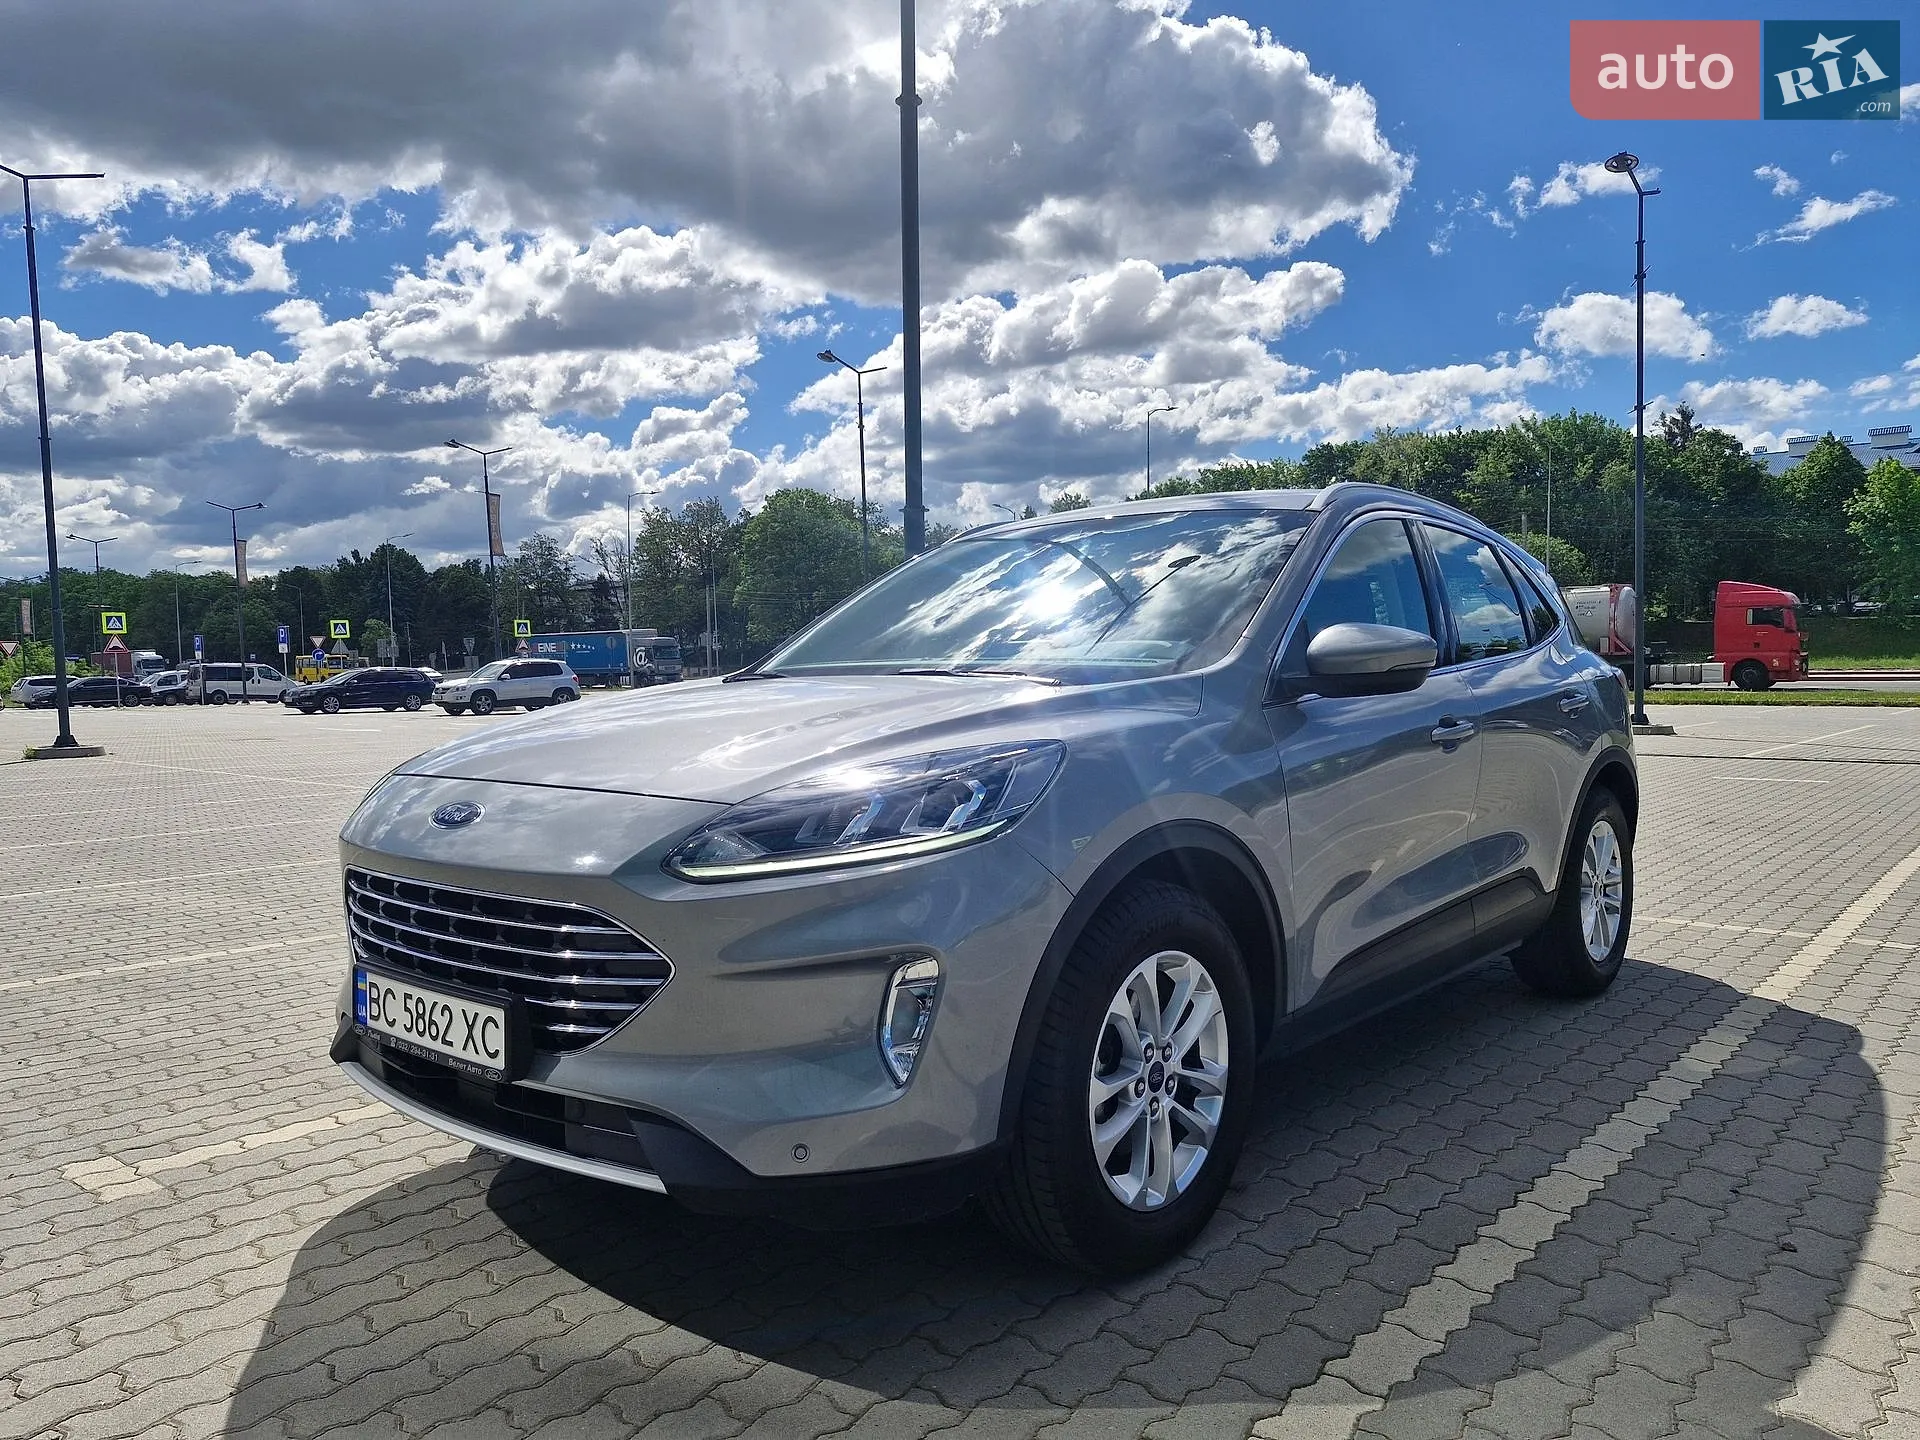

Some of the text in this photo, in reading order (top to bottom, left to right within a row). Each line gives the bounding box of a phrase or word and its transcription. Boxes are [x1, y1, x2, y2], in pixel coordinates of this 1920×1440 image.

[357, 1003, 367, 1018] UA
[368, 981, 500, 1060] BC 5862 XC
